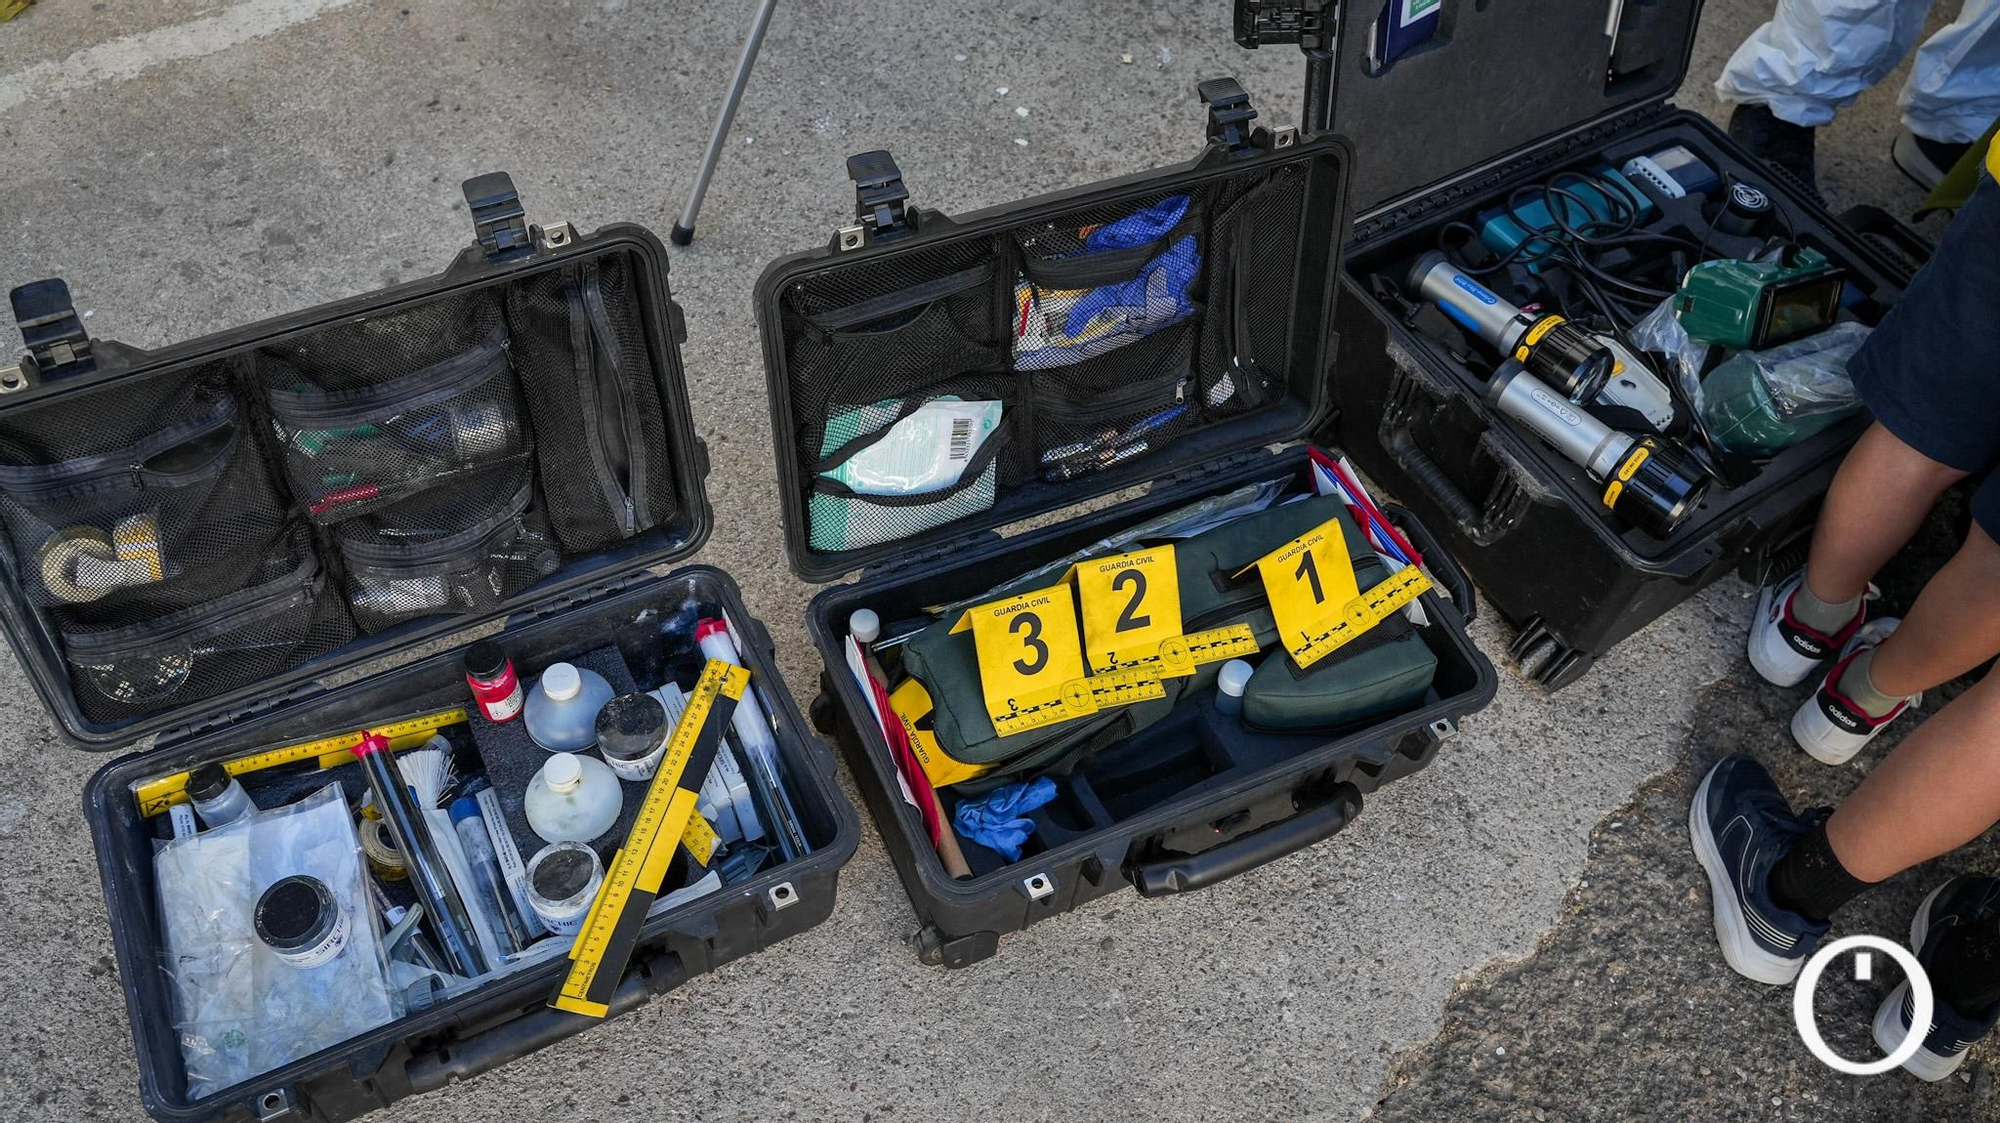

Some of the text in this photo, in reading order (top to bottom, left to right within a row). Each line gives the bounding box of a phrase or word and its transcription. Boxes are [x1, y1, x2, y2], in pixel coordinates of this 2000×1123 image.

[1277, 534, 1324, 563] GUARDIA CIVIL
[1099, 555, 1154, 573] GUARDIA CIVIL
[1295, 550, 1325, 604] 1
[994, 596, 1050, 617] GUARDIA CIVIL
[1112, 569, 1150, 633] 2
[1008, 612, 1049, 676] 3
[1300, 631, 1310, 642] 1
[1794, 635, 1821, 654] adidas
[1107, 652, 1118, 664] 2
[1007, 698, 1018, 711] 3
[1828, 704, 1858, 728] adidas
[900, 712, 930, 764] GUARDIA CIVIL
